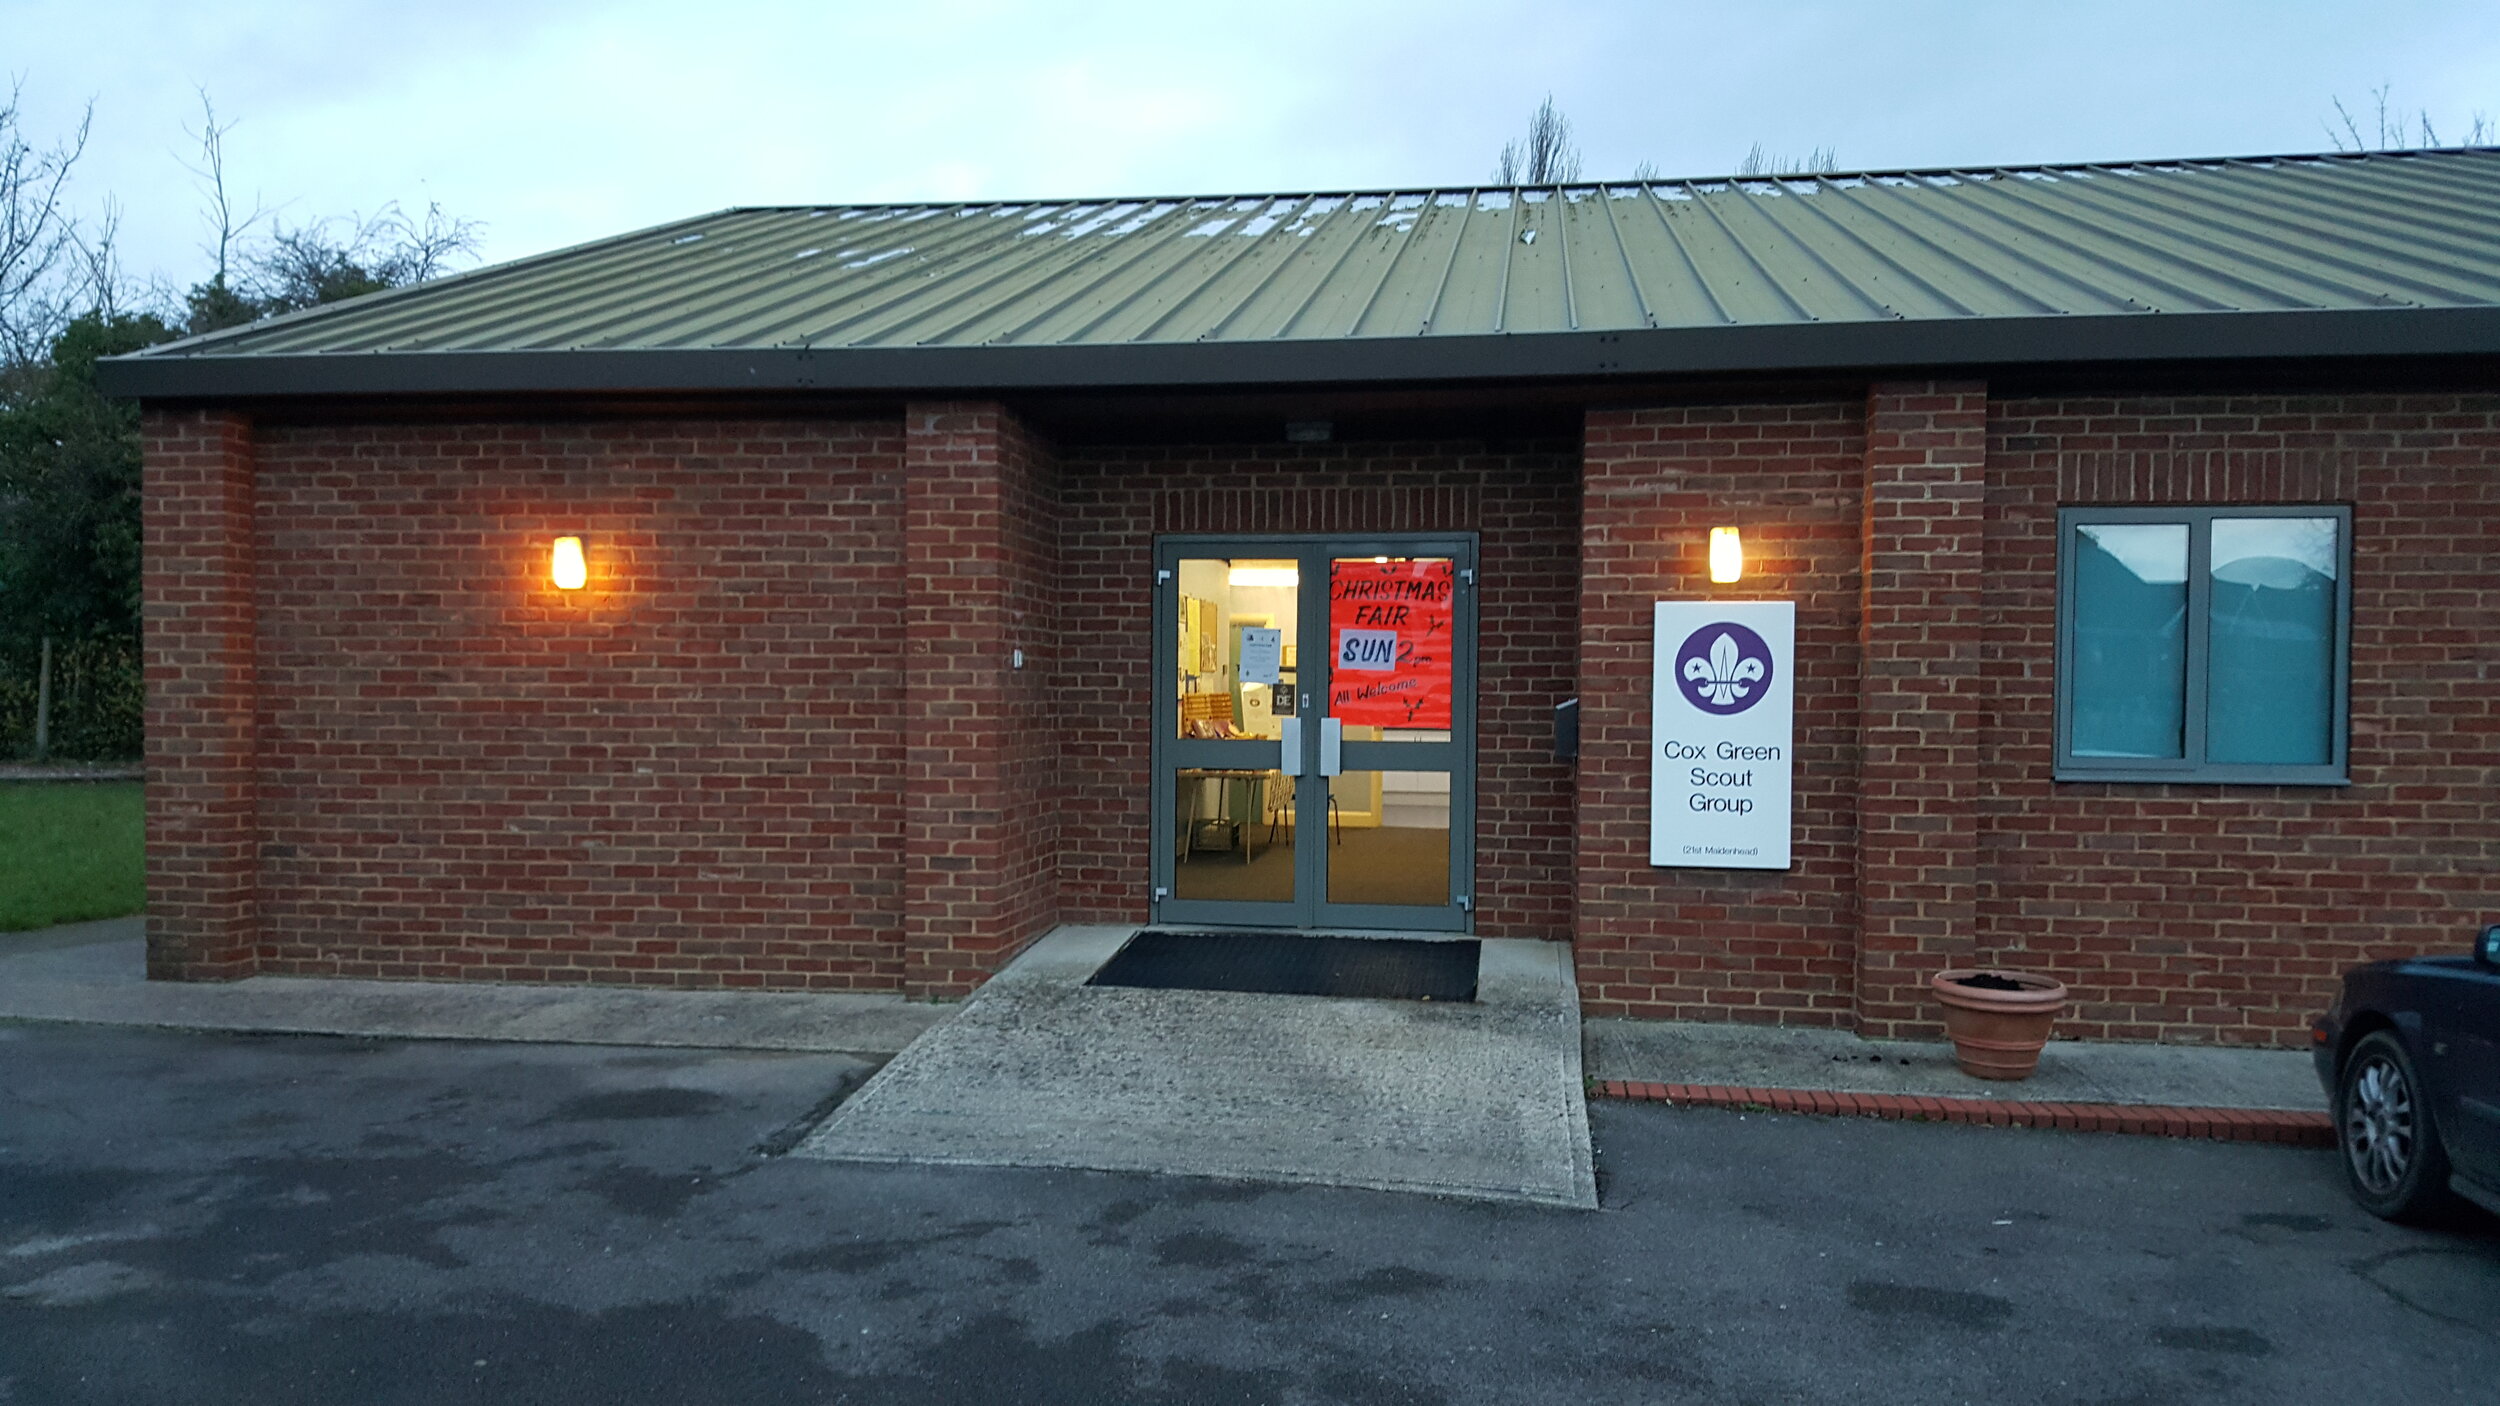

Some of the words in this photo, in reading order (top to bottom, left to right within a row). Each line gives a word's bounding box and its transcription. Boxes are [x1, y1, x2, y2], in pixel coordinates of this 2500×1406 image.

[1330, 579, 1450, 601] CHRISTMAS
[1354, 605, 1410, 626] FAIR
[1342, 637, 1394, 663] SUN
[1334, 689, 1350, 706] All
[1356, 678, 1418, 701] Welcome
[1664, 740, 1706, 760] Cox
[1716, 741, 1781, 760] Green
[1690, 767, 1753, 787] Scout
[1689, 793, 1753, 816] Group
[1682, 845, 1702, 855] (21st
